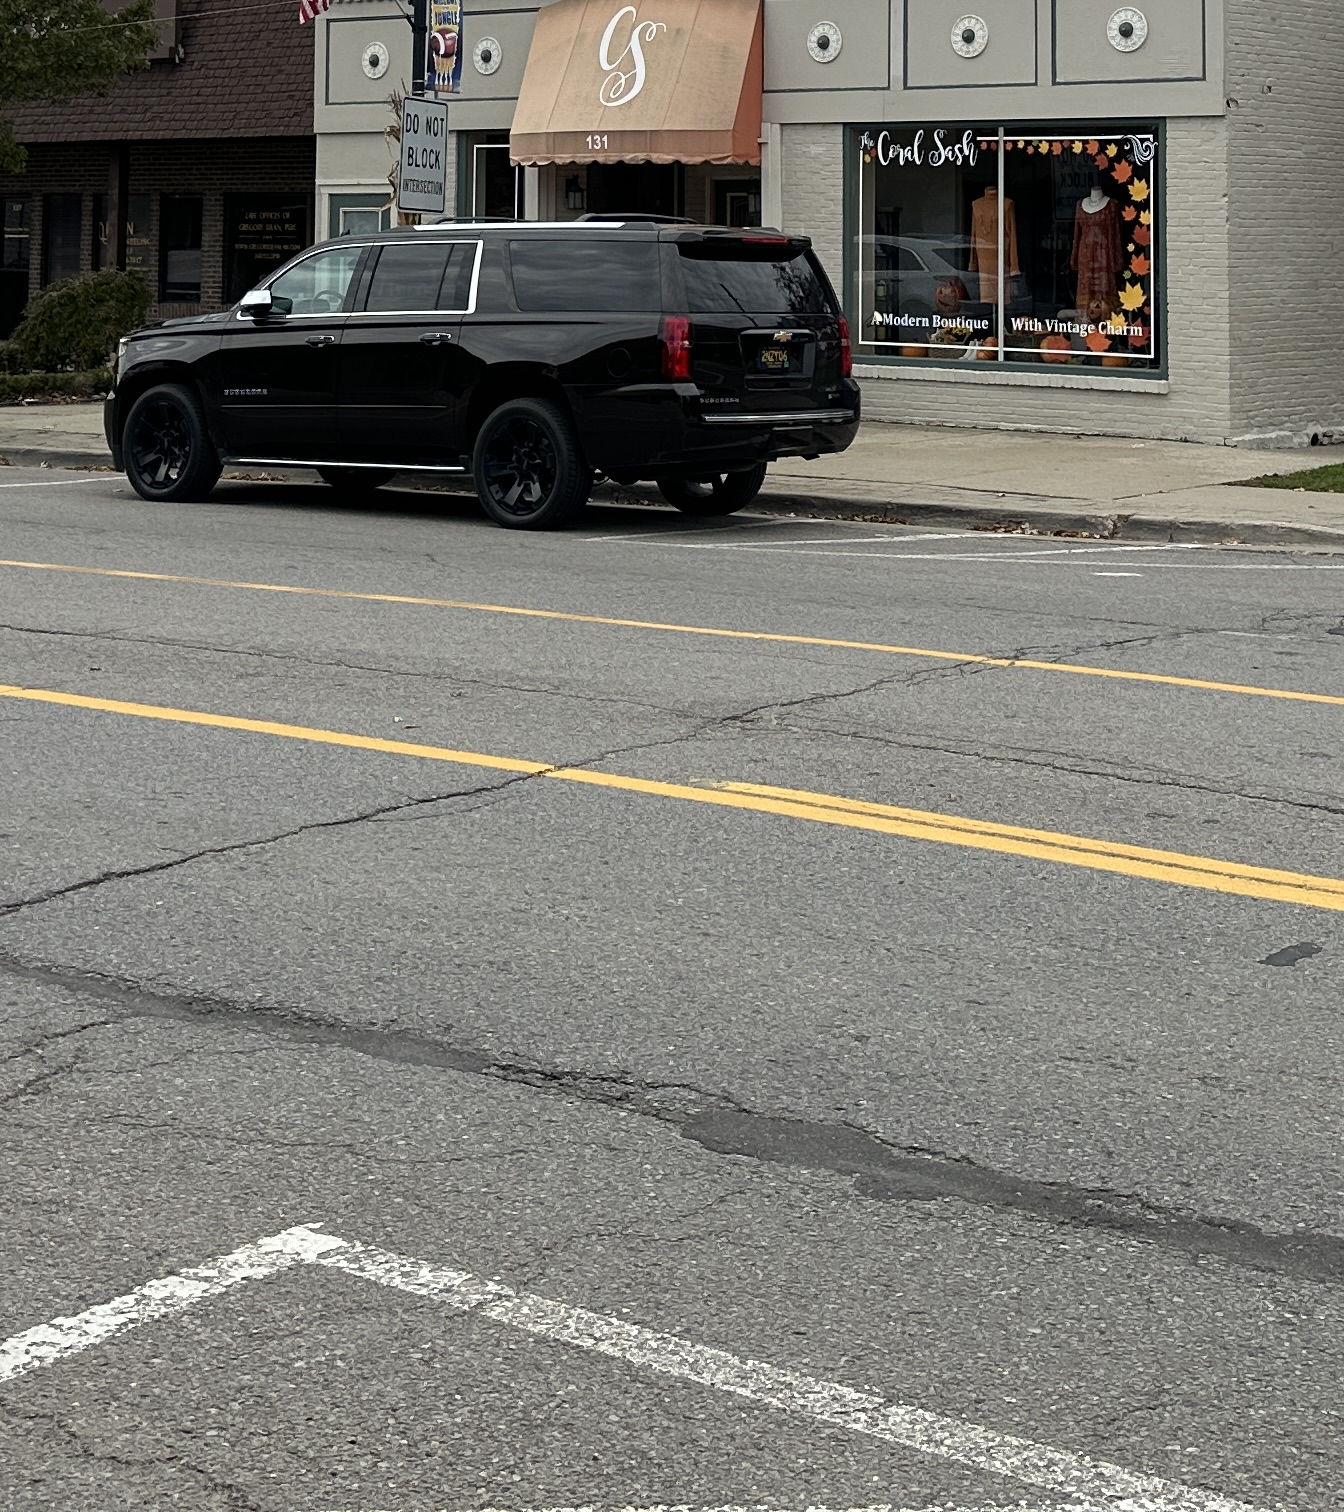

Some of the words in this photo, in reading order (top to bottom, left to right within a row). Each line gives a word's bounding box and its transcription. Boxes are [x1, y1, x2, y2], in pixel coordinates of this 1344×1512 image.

[406, 112, 419, 135] DO
[425, 115, 445, 138] NOT
[586, 134, 608, 150] 131
[859, 130, 875, 150] The
[877, 130, 924, 166] Coral
[928, 129, 978, 166] Sash
[407, 146, 441, 170] BLOCK
[403, 178, 443, 196] INTERSECTION
[882, 313, 930, 328] Modern
[932, 315, 989, 332] Boutique
[1011, 317, 1042, 332] With
[1045, 319, 1096, 337] Vintage
[1098, 321, 1143, 337] Charm
